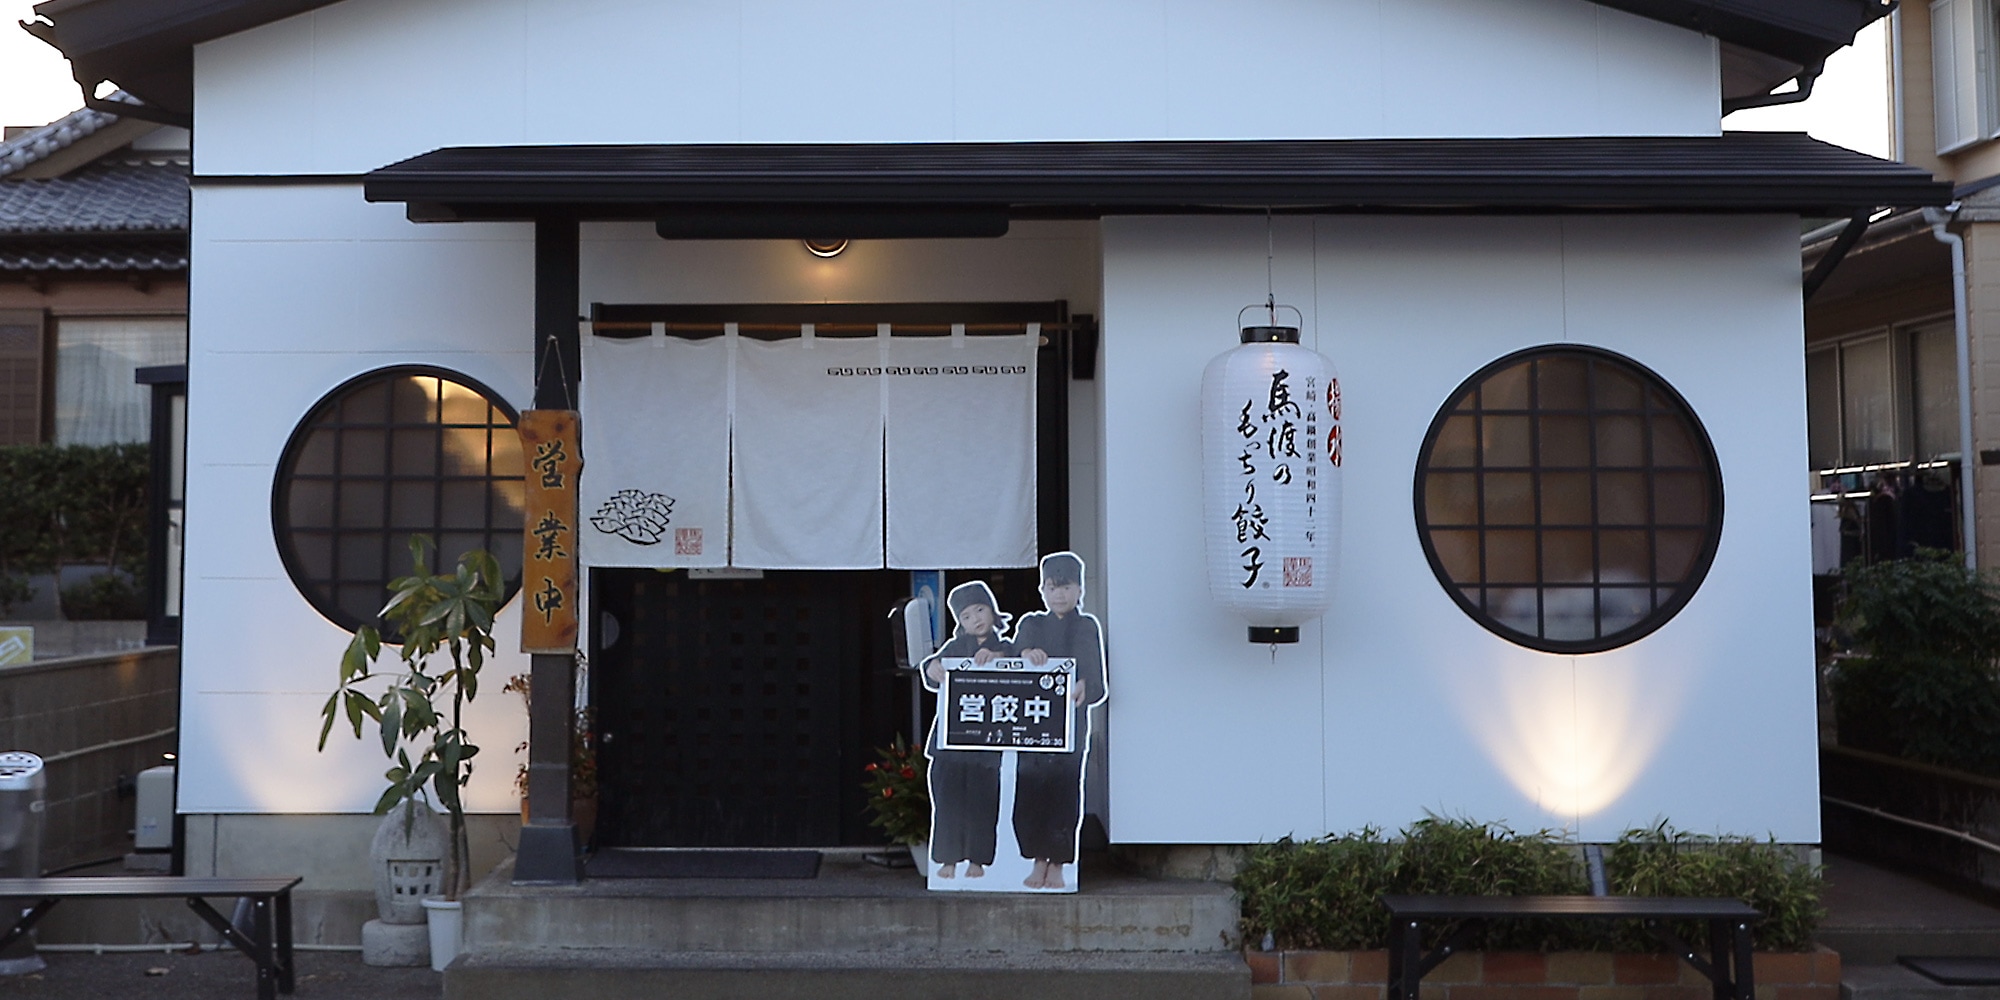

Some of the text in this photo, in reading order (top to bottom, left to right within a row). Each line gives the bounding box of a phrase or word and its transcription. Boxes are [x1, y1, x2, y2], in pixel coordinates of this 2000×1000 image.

[532, 440, 567, 625] 営業中
[959, 694, 1051, 724] 営餃中
